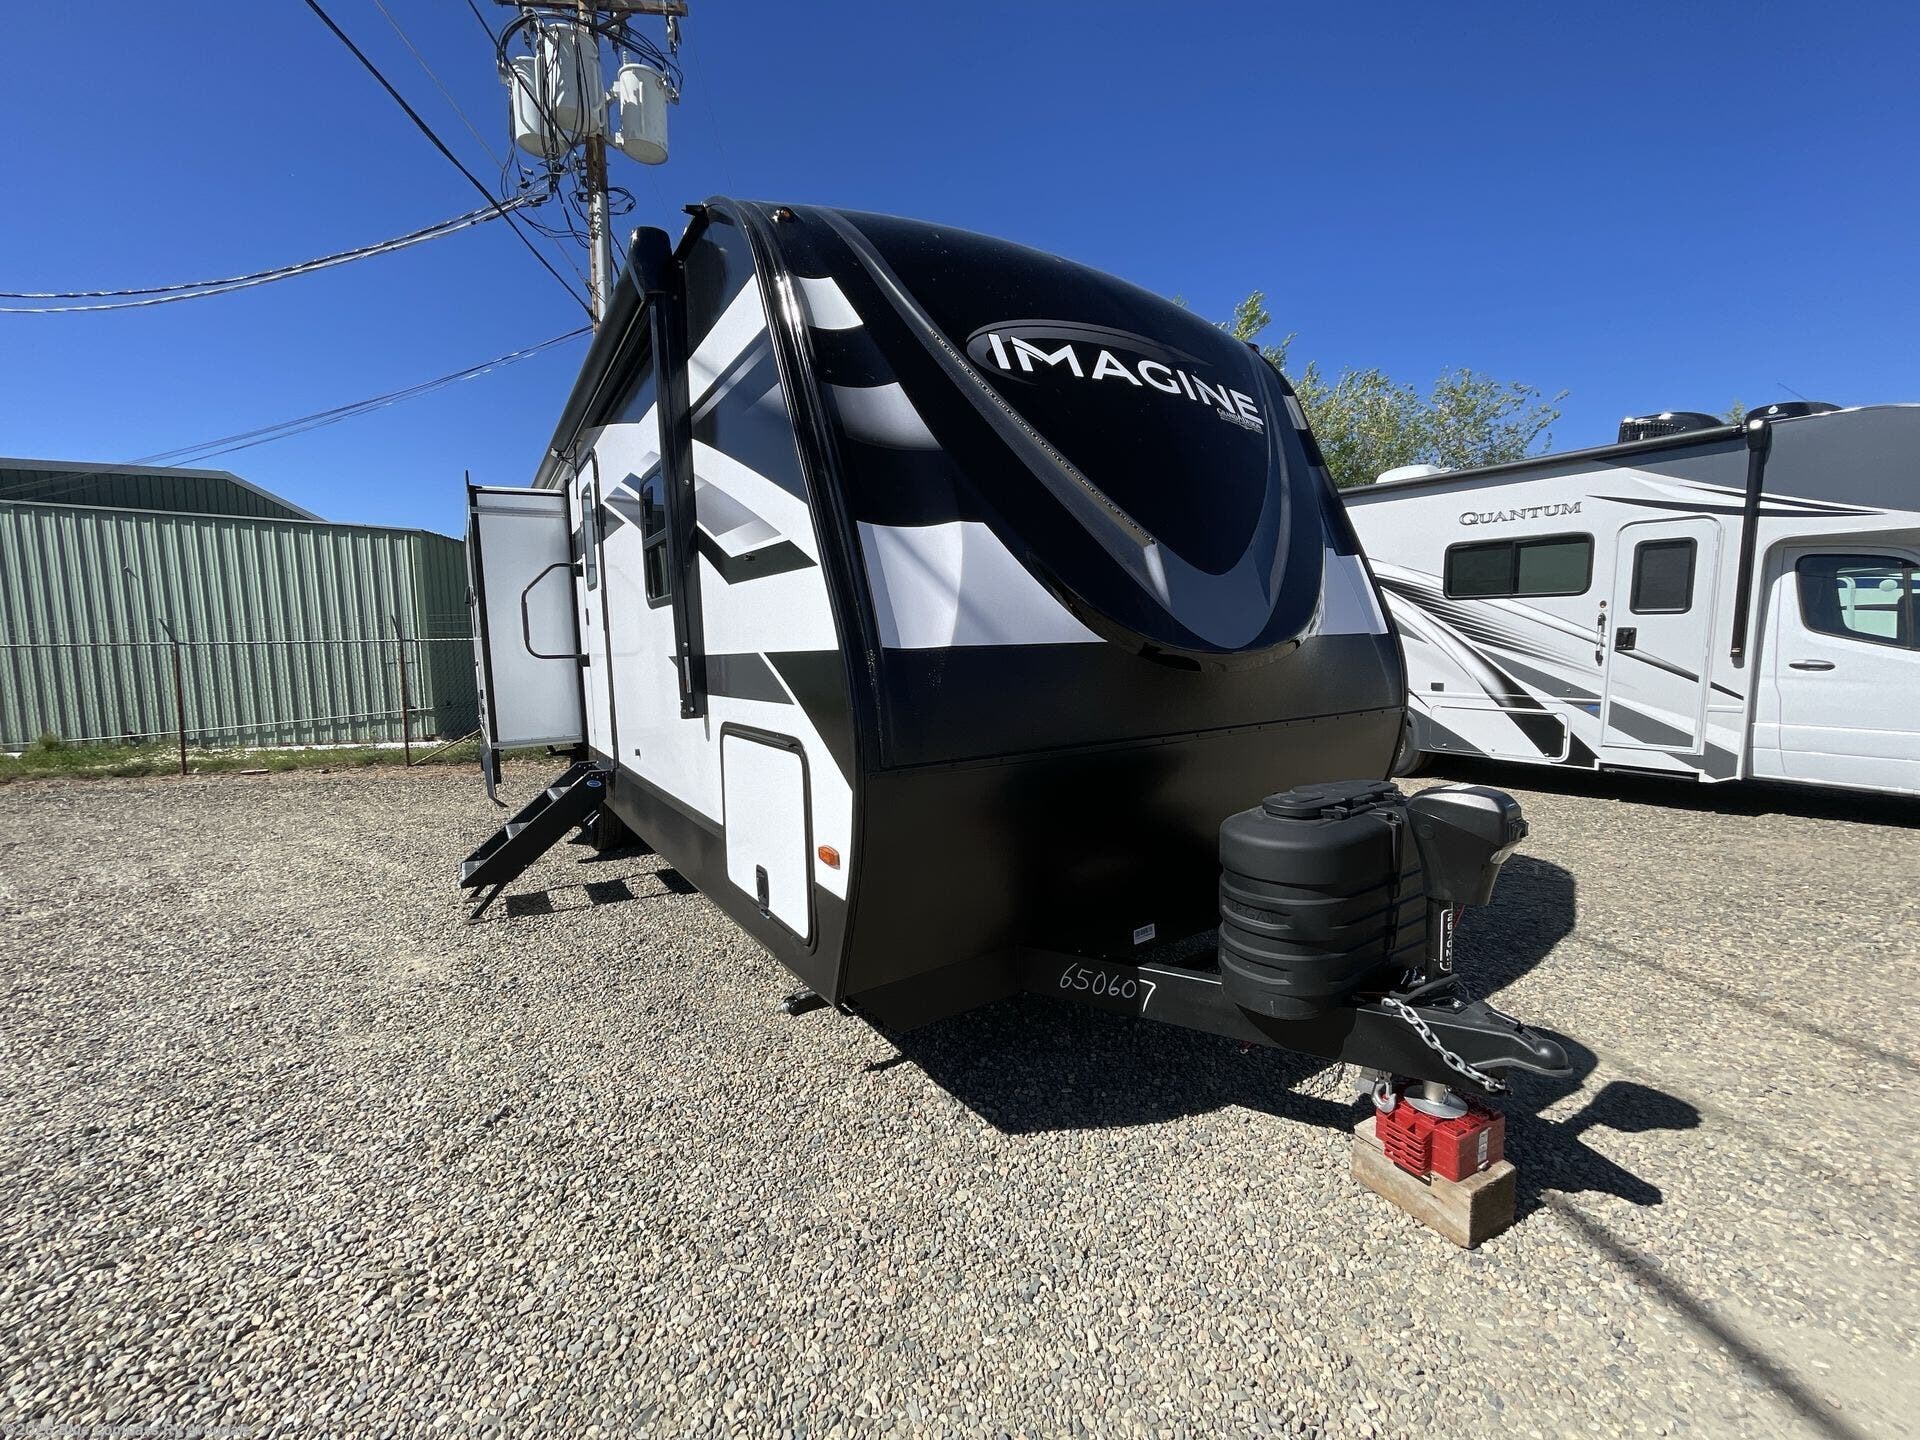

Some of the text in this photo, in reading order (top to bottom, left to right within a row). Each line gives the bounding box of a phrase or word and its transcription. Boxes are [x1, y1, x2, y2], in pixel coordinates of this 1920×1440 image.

[987, 333, 1264, 426] IMAGINE
[1459, 501, 1582, 526] QUANTUM
[1059, 962, 1157, 1013] 650607
